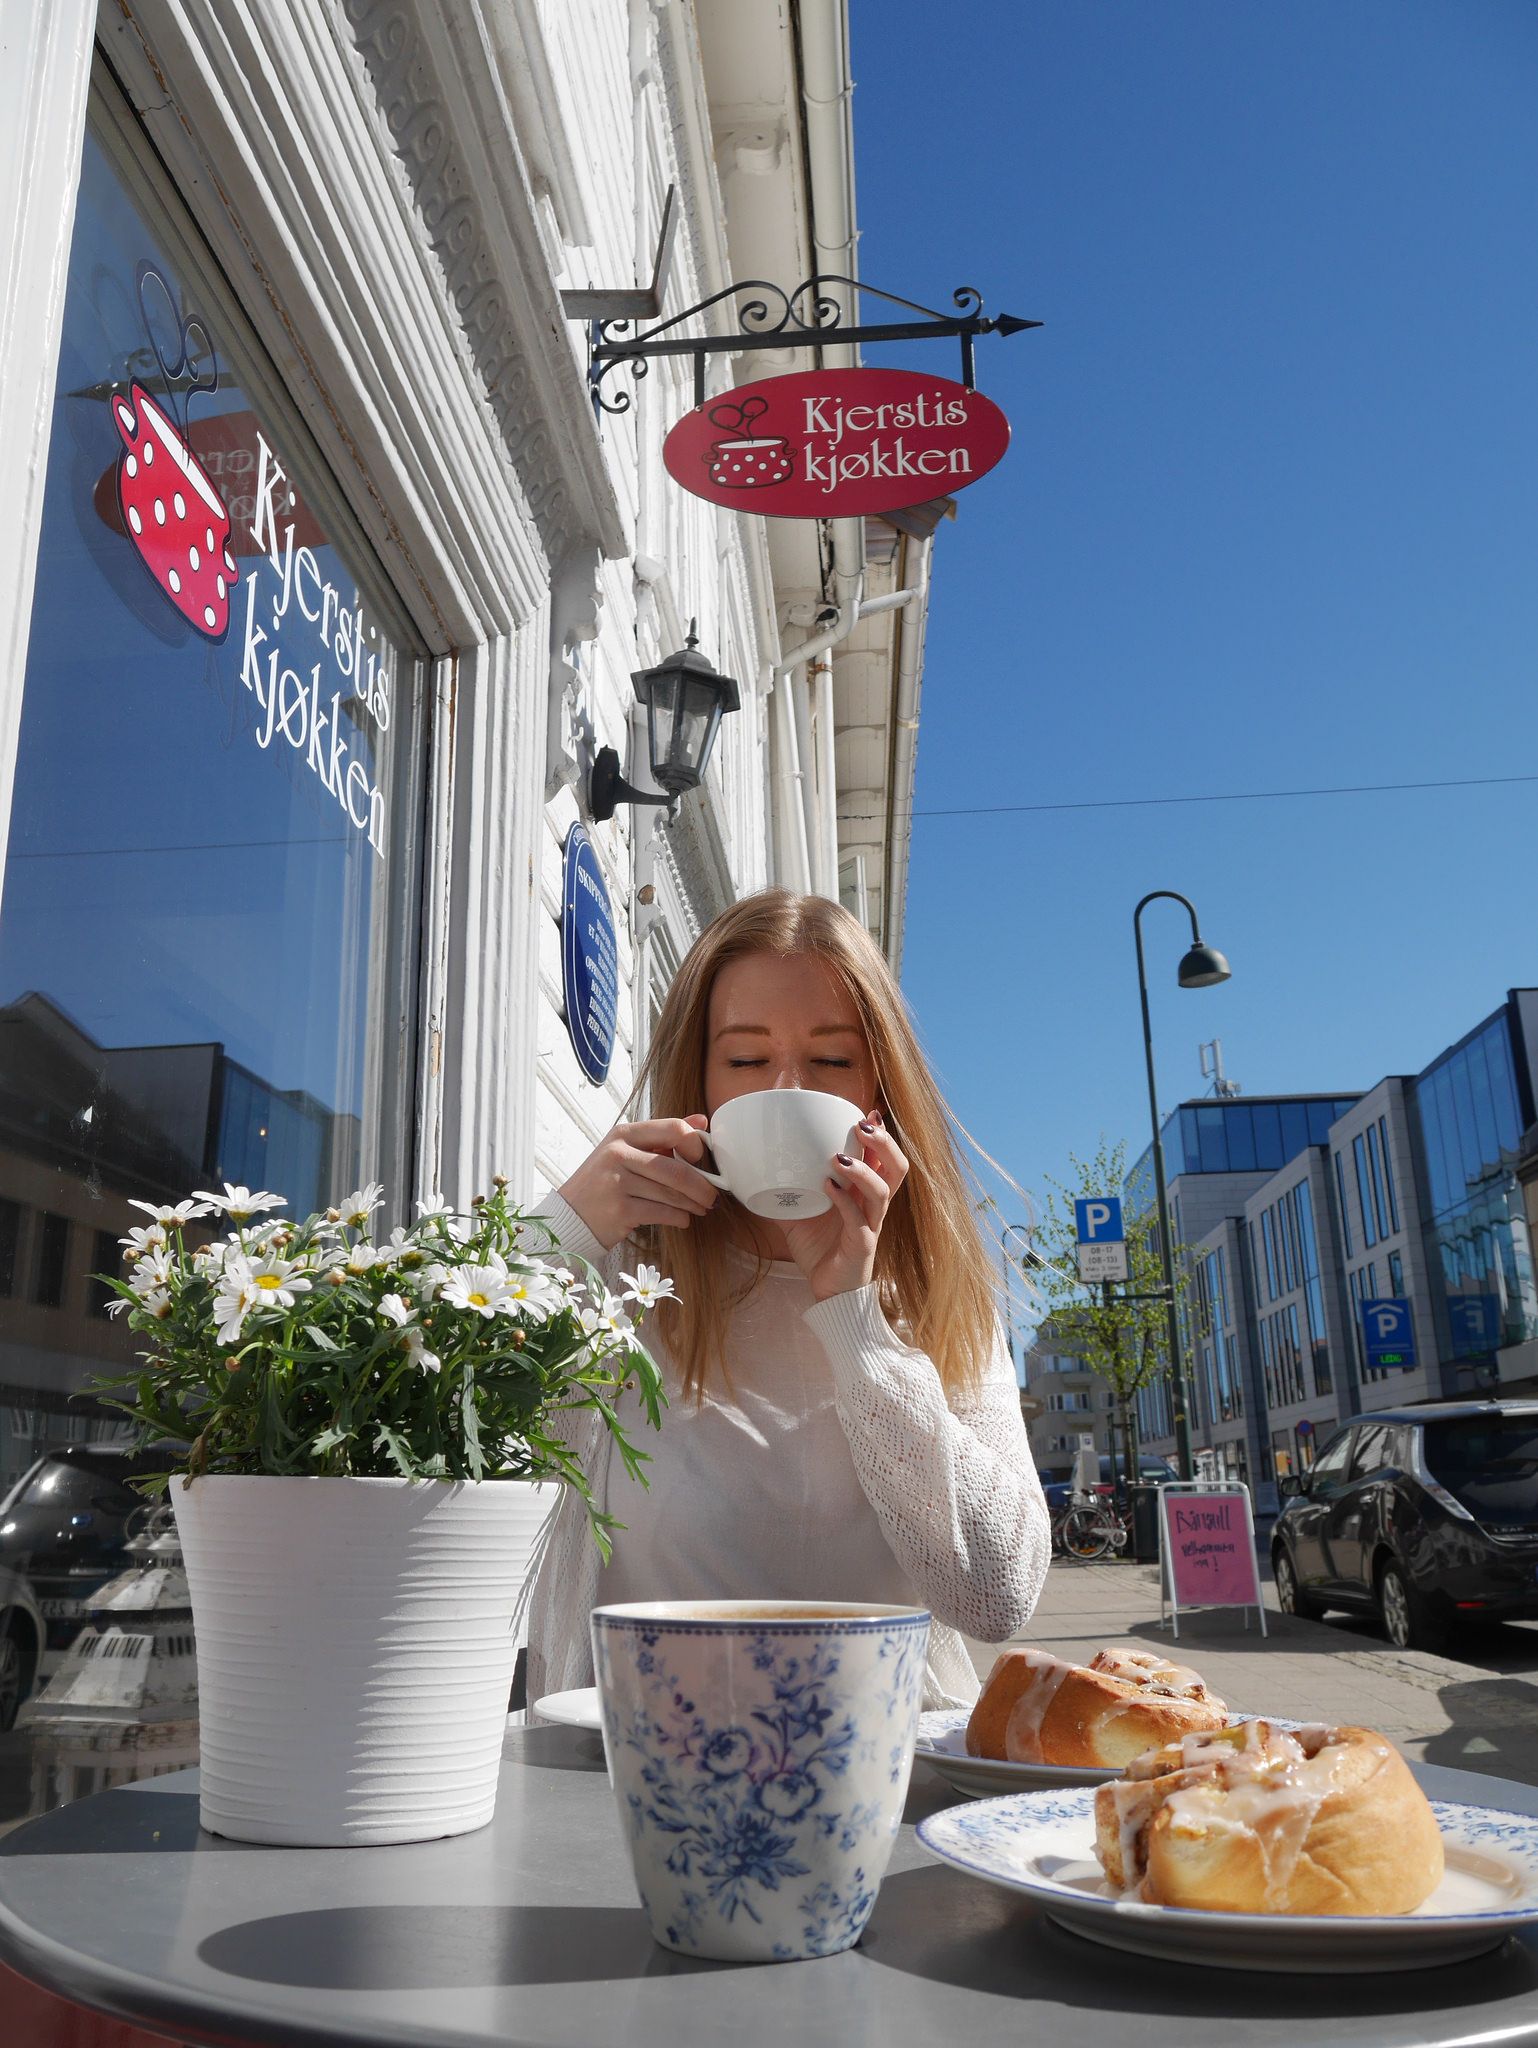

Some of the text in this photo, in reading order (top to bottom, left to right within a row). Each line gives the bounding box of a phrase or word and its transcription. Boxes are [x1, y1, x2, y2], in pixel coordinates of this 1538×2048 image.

[802, 391, 968, 445] Kjerstis
[803, 437, 973, 494] kjøkken
[251, 431, 390, 732] Kjerstis
[240, 571, 385, 859] kjøkken
[1086, 1203, 1111, 1238] P
[1377, 1313, 1398, 1338] P
